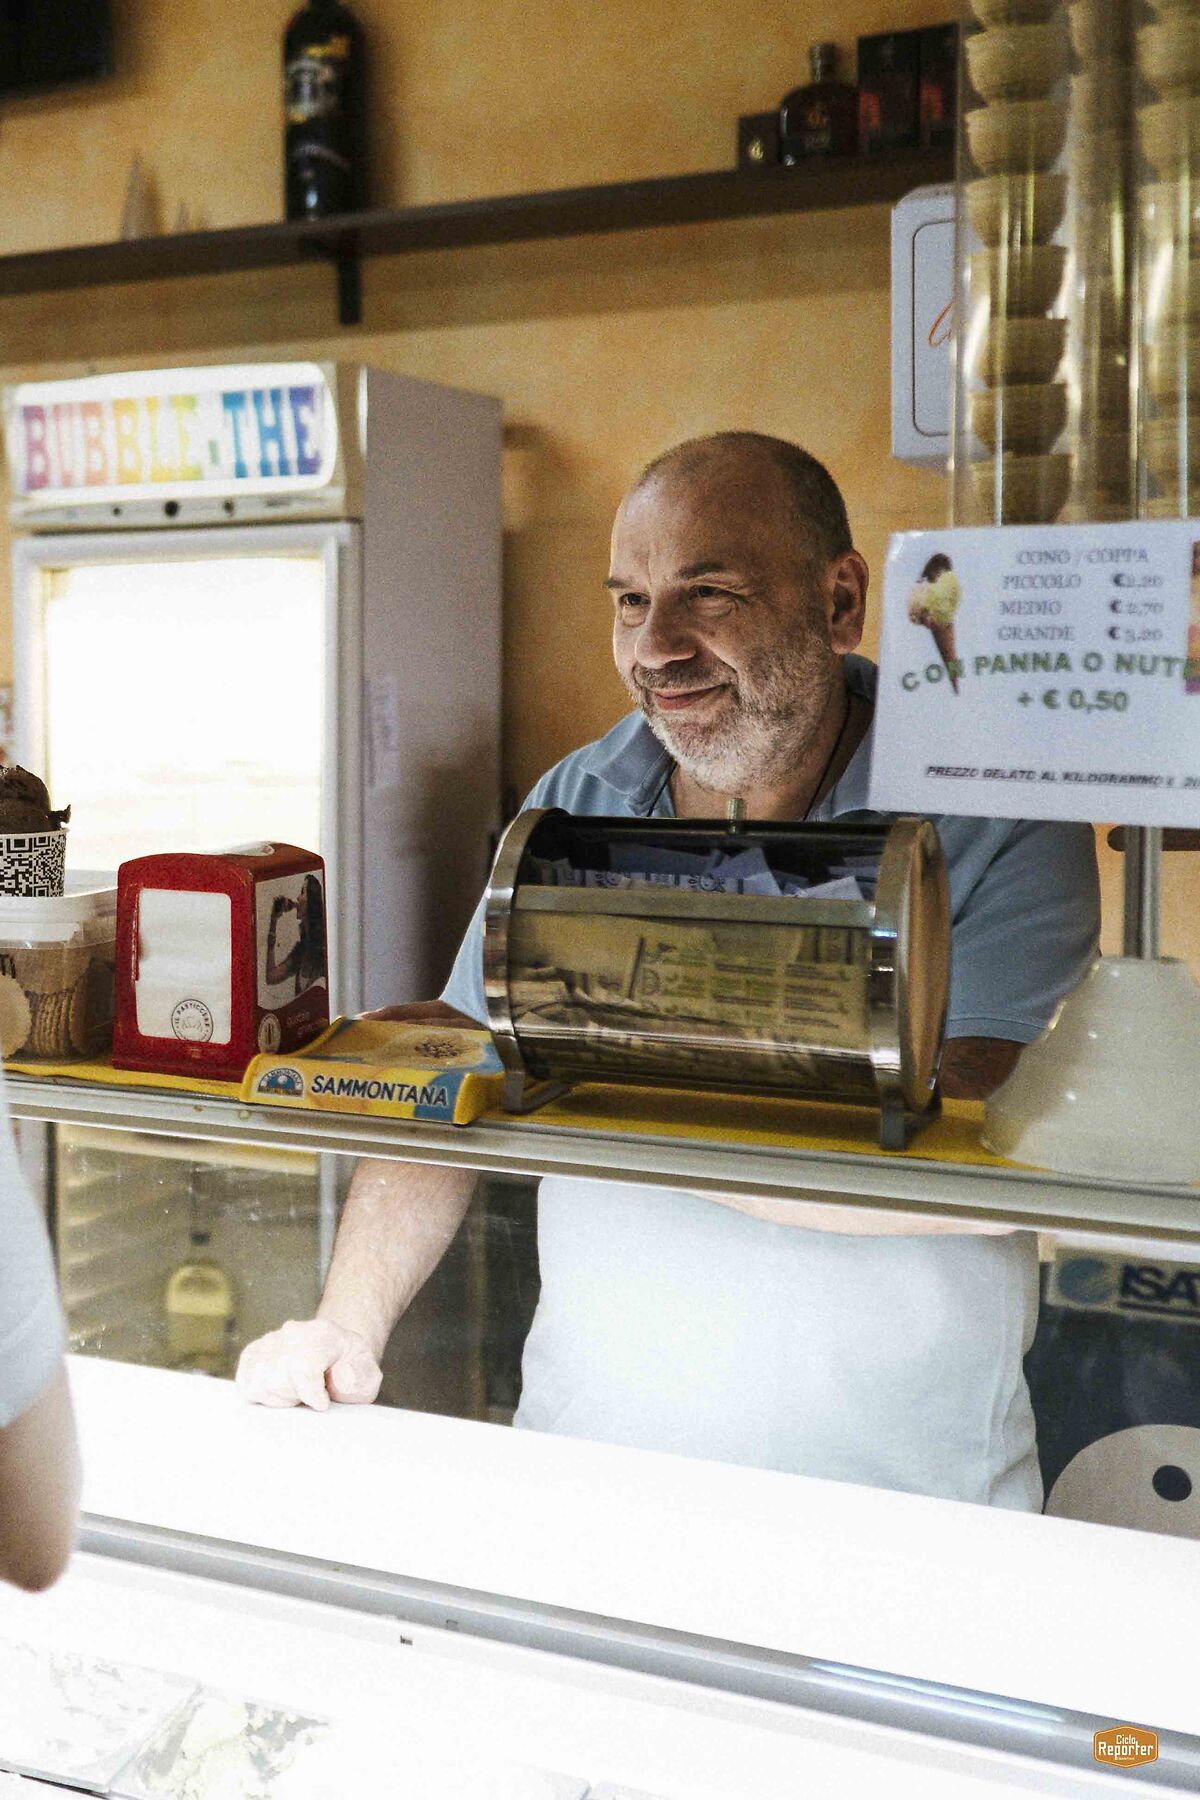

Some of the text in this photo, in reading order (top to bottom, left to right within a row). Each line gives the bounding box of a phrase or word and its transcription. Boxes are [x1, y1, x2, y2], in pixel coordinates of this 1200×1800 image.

[1016, 550, 1071, 565] CONO
[1086, 548, 1148, 564] COPPA
[1003, 574, 1081, 589] PICCOLO
[1000, 600, 1062, 616] MEDIO
[998, 625, 1075, 641] GRANDE
[902, 660, 965, 692] CON
[975, 652, 1072, 677] PANNA
[1083, 652, 1104, 673] O
[1043, 690, 1060, 709] €
[1069, 689, 1130, 713] 0,50
[926, 765, 979, 779] PREZZO
[983, 768, 1036, 781] GELATO
[1041, 770, 1056, 782] AL
[311, 1075, 449, 1107] SAMMONTANA
